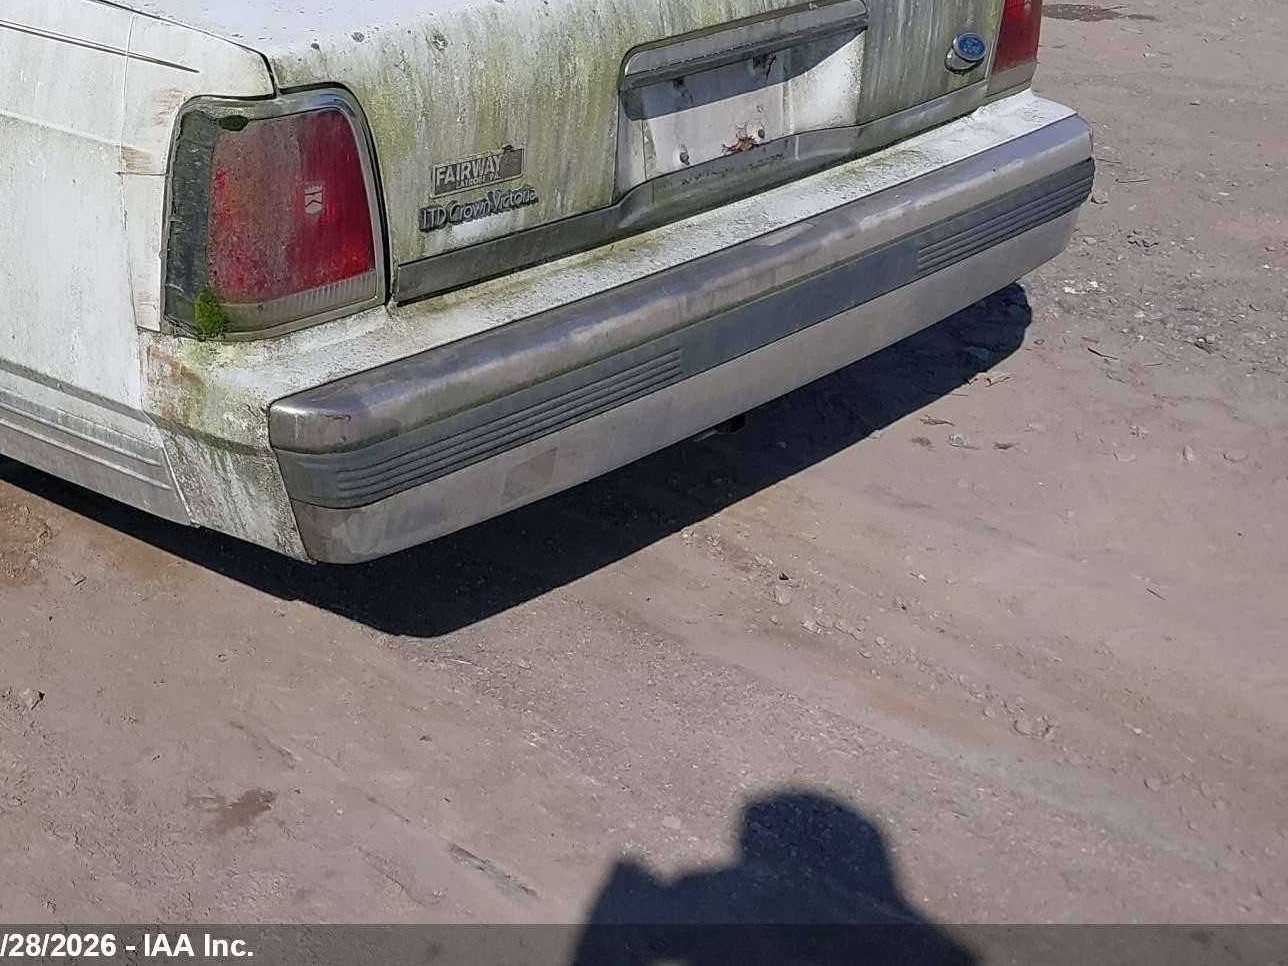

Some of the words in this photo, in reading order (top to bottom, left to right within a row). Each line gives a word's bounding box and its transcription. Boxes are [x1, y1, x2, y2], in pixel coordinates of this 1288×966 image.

[435, 154, 502, 187] FAIRWAY
[449, 200, 492, 225] Crown
[487, 185, 540, 216] Victoria
